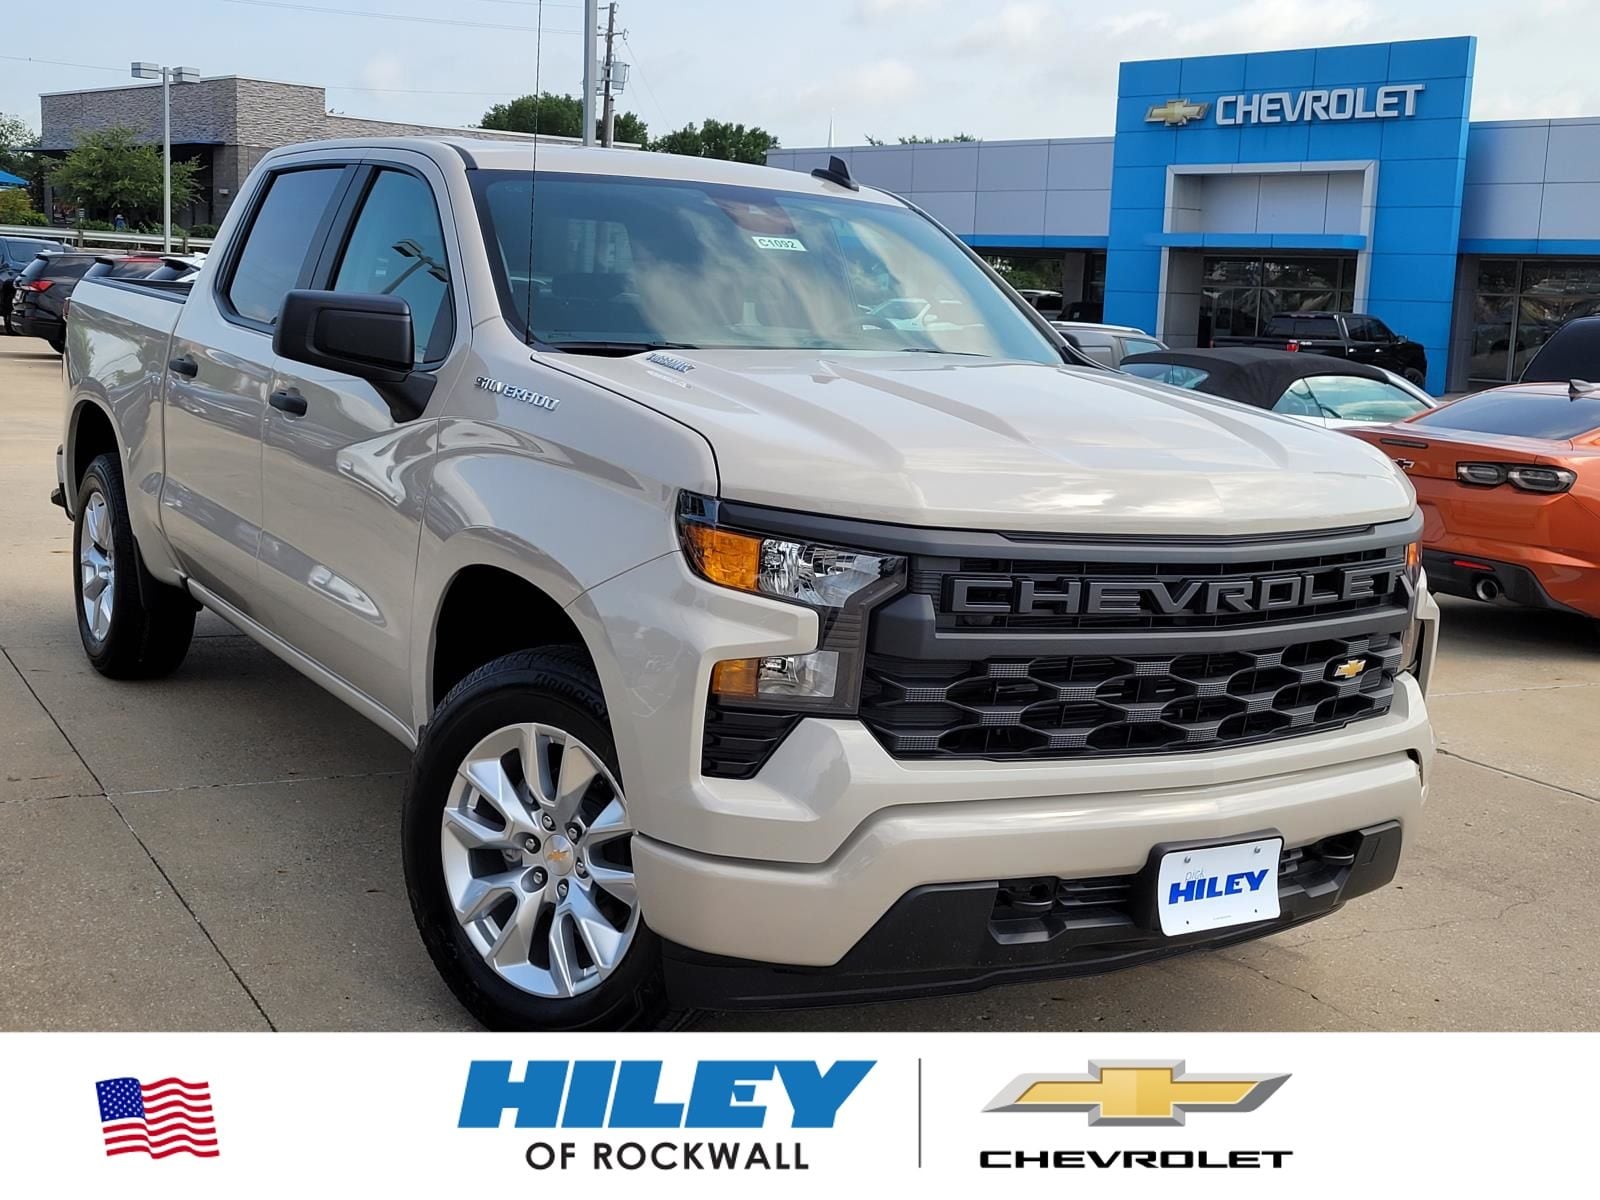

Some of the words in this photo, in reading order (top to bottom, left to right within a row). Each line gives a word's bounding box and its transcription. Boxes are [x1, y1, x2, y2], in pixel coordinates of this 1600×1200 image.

[1215, 83, 1425, 126] CHEVROLET
[758, 238, 797, 249] C1092
[474, 376, 561, 411] SILVERADO
[944, 562, 1405, 614] CHEVROLET
[1168, 868, 1270, 905] HILEY
